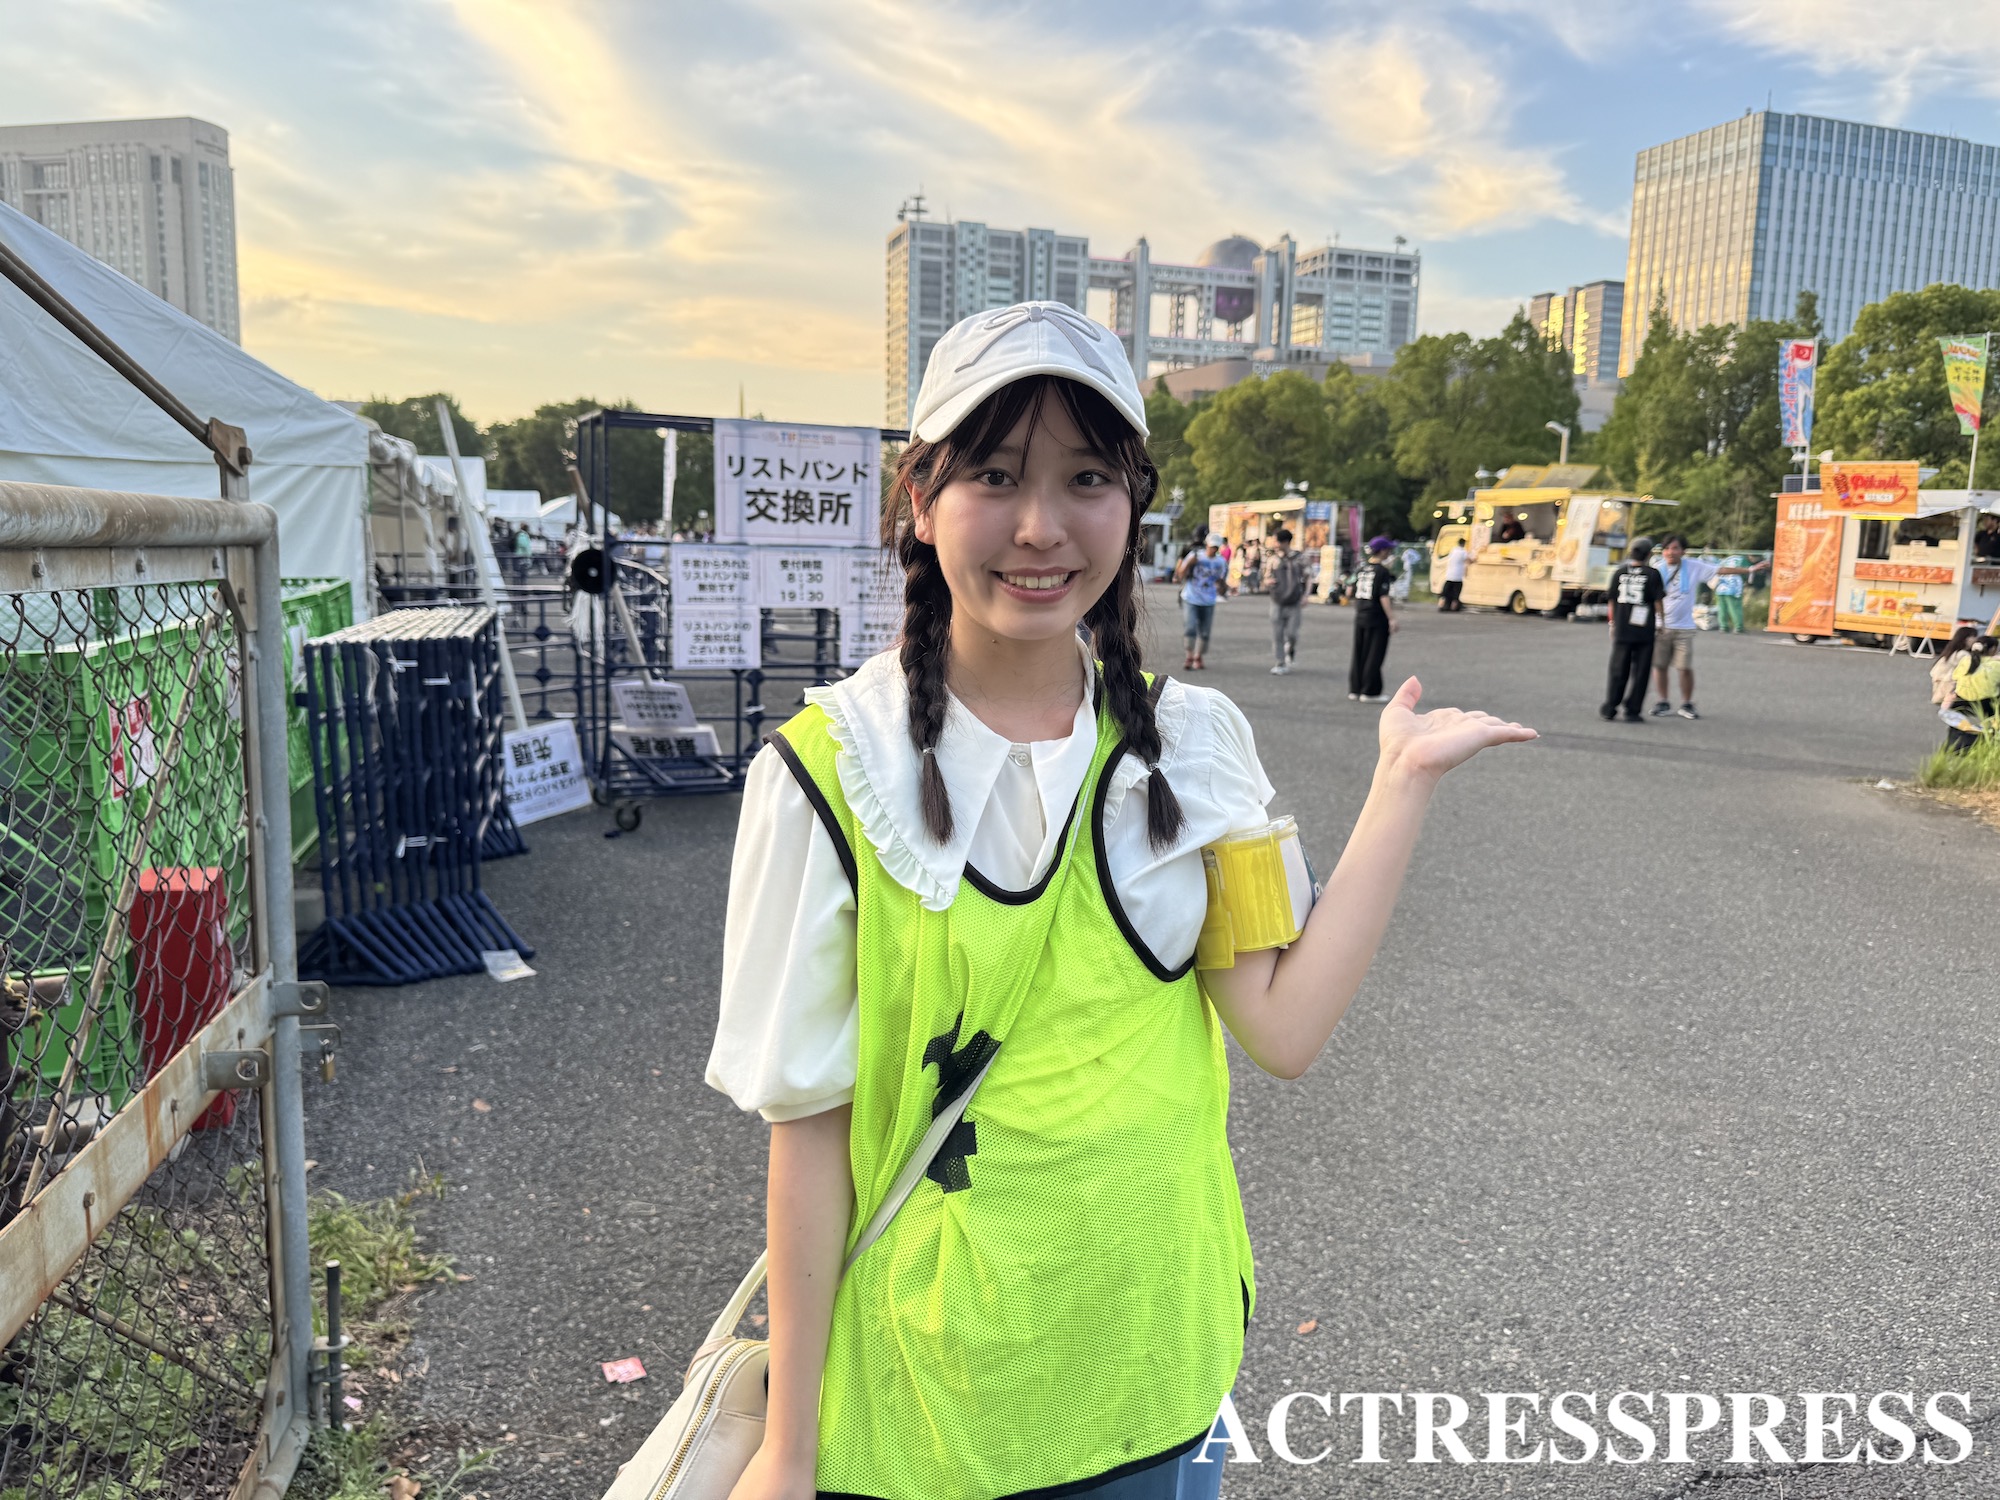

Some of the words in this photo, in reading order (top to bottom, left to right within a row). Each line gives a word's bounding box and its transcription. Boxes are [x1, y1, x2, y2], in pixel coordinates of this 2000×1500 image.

[727, 455, 870, 484] リストバンド
[745, 488, 852, 526] 交換所
[780, 559, 823, 570] 受付時間
[1617, 584, 1646, 605] 15
[511, 736, 552, 768] 先頭
